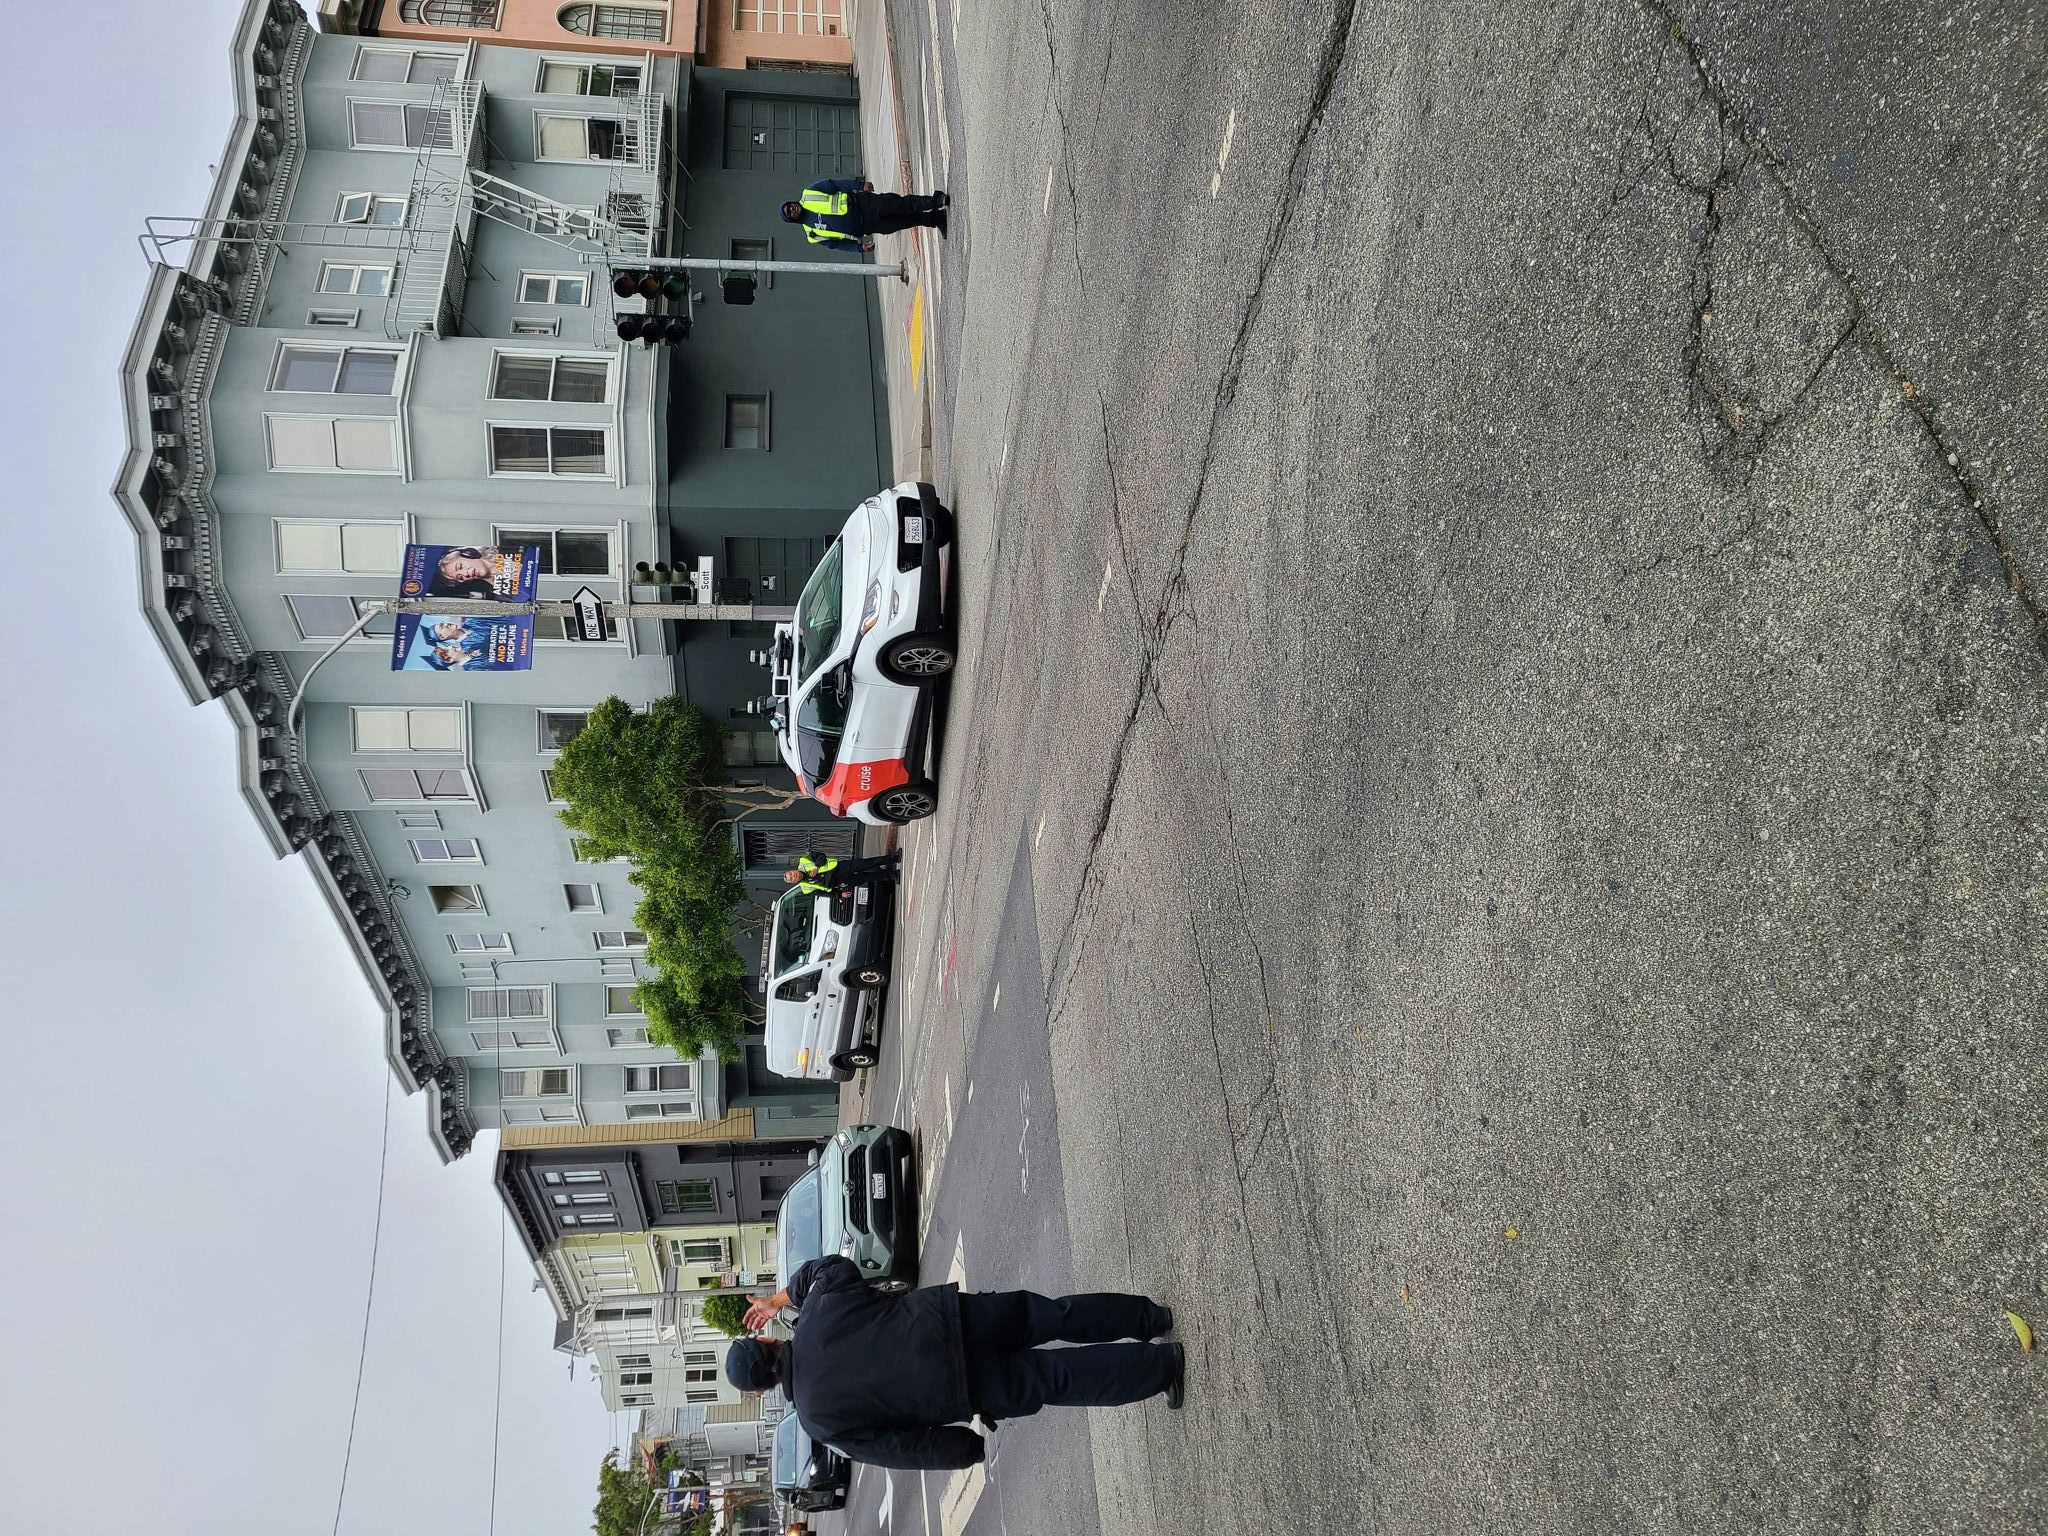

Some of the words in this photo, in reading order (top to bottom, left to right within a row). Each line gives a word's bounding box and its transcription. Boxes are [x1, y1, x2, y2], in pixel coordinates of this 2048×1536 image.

[496, 553, 505, 573] AND
[502, 553, 513, 595] ACADEMIC
[511, 553, 522, 595] EXCELLENCE
[525, 561, 534, 587] HSArts.org
[701, 571, 709, 590] Scott
[492, 574, 503, 596] ARTS
[583, 605, 596, 620] WAY
[498, 625, 508, 644] SELF-
[586, 623, 598, 637] ONE
[397, 640, 405, 658] Grades
[489, 625, 498, 663] INSPIRATION
[497, 645, 506, 663] AND
[506, 624, 517, 663] DISCIPLINE
[857, 765, 871, 791] cruise
